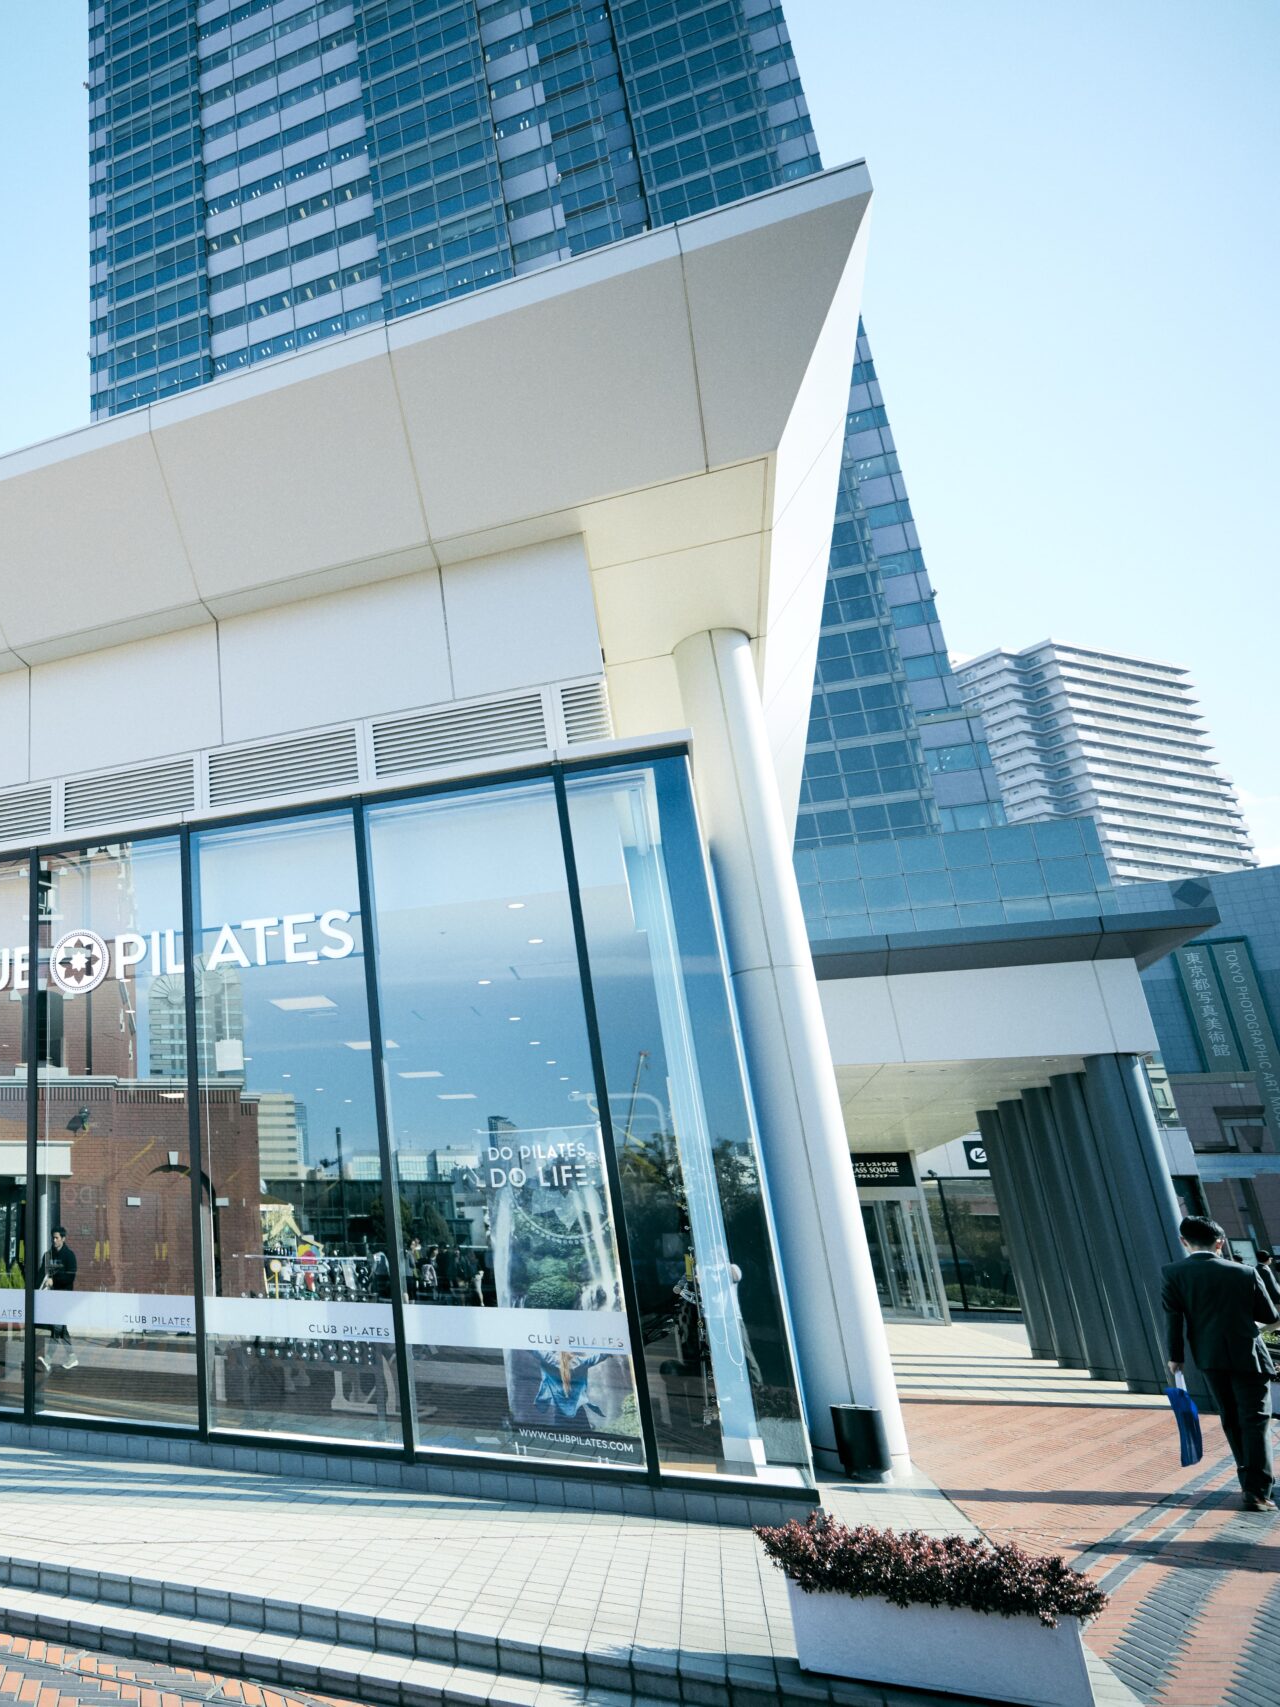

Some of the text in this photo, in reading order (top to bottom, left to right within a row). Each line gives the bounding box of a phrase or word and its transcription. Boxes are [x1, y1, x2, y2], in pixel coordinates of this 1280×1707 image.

[114, 909, 356, 980] PILATES
[1184, 952, 1231, 1057] 東京都写真美術館
[1224, 948, 1246, 983] TOKYO
[1235, 986, 1272, 1069] PHOTOGRAPHIC
[1263, 1072, 1280, 1093] ART
[488, 1147, 513, 1161] DO
[490, 1167, 527, 1188] DO
[869, 1166, 899, 1175] SQUARE
[308, 1324, 337, 1334] CLUB
[518, 1428, 635, 1454] WWW.CLUBPILATES.COM
